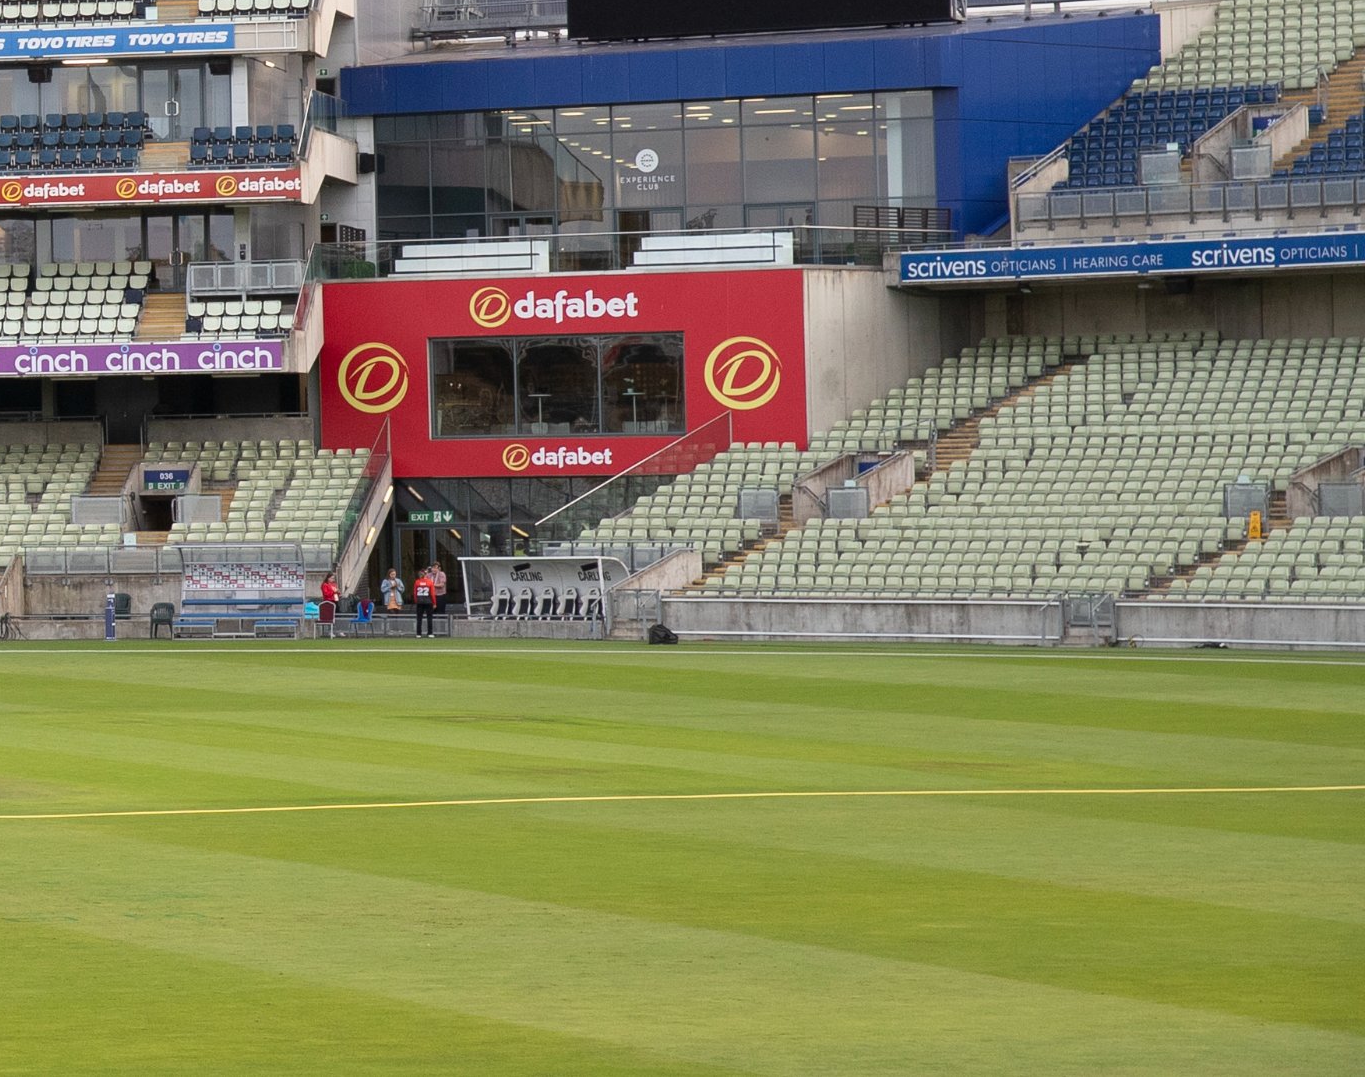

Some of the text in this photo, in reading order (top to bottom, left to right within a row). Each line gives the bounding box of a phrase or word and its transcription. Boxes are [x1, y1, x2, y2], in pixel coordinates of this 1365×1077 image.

[18, 37, 64, 49] TOYO
[66, 35, 116, 47] TIRES
[129, 33, 175, 45] TOYO
[177, 31, 228, 43] TIRES
[24, 183, 84, 199] dafabet
[138, 179, 200, 196] dafabet
[238, 176, 301, 194] dafabet
[620, 175, 675, 183] EXPERIENCE
[908, 244, 1347, 277] scrivens OPTICIANS HEARING CARE scrivens OPTICIANS
[514, 290, 638, 323] dafabet
[14, 346, 87, 373] cinch
[105, 344, 179, 370] cinch
[197, 343, 273, 369] cinch
[532, 447, 612, 468] dafabet
[411, 513, 429, 521] EXIT
[510, 572, 543, 582] CARLING
[417, 587, 429, 596] 22
